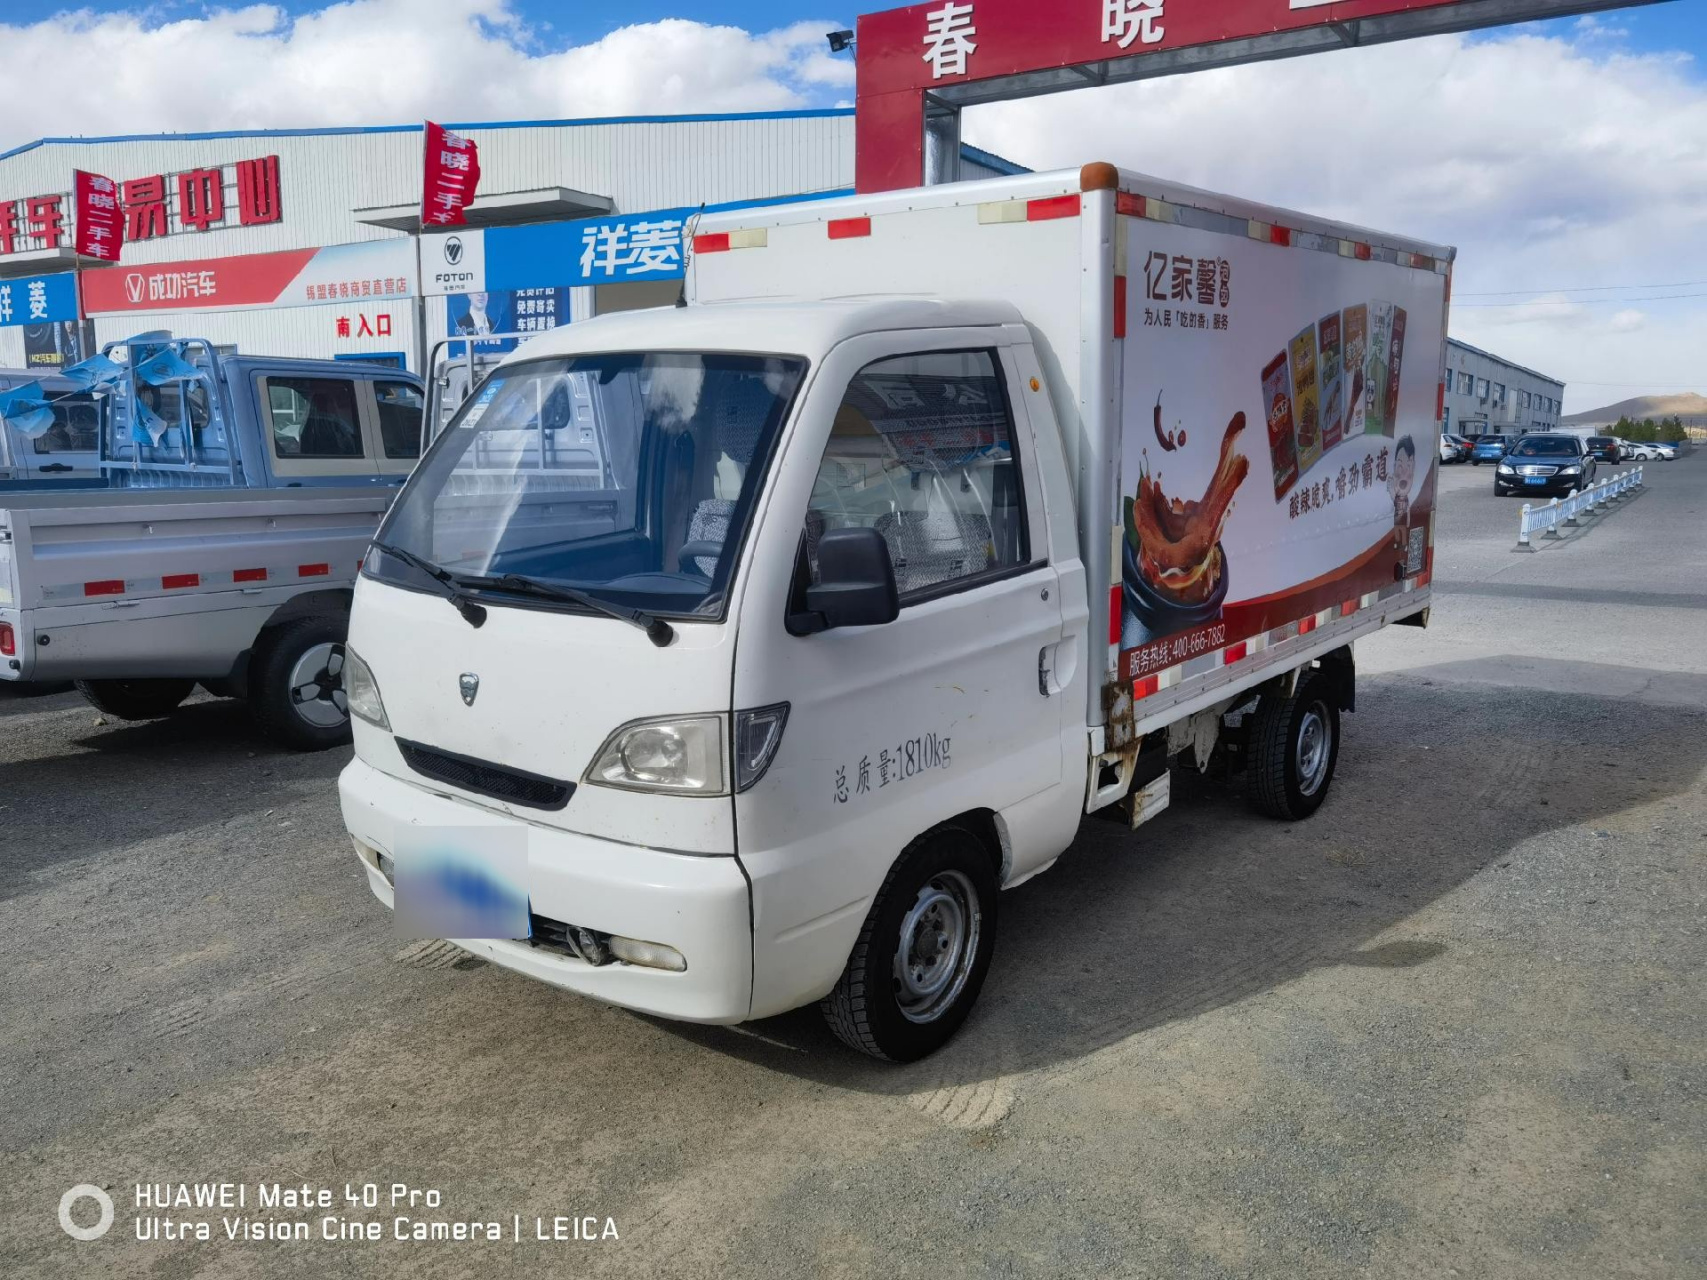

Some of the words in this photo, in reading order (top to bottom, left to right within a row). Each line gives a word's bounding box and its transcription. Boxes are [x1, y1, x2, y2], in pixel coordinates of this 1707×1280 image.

[85, 175, 115, 258] 春晓二手车
[579, 218, 684, 279] 祥菱
[148, 270, 217, 302] 成功汽车
[306, 277, 407, 301] 锡盟春晓商贸直营店
[435, 272, 474, 283] FOTON
[336, 313, 392, 339] 南入口
[833, 732, 951, 804] 总质量:1810kg
